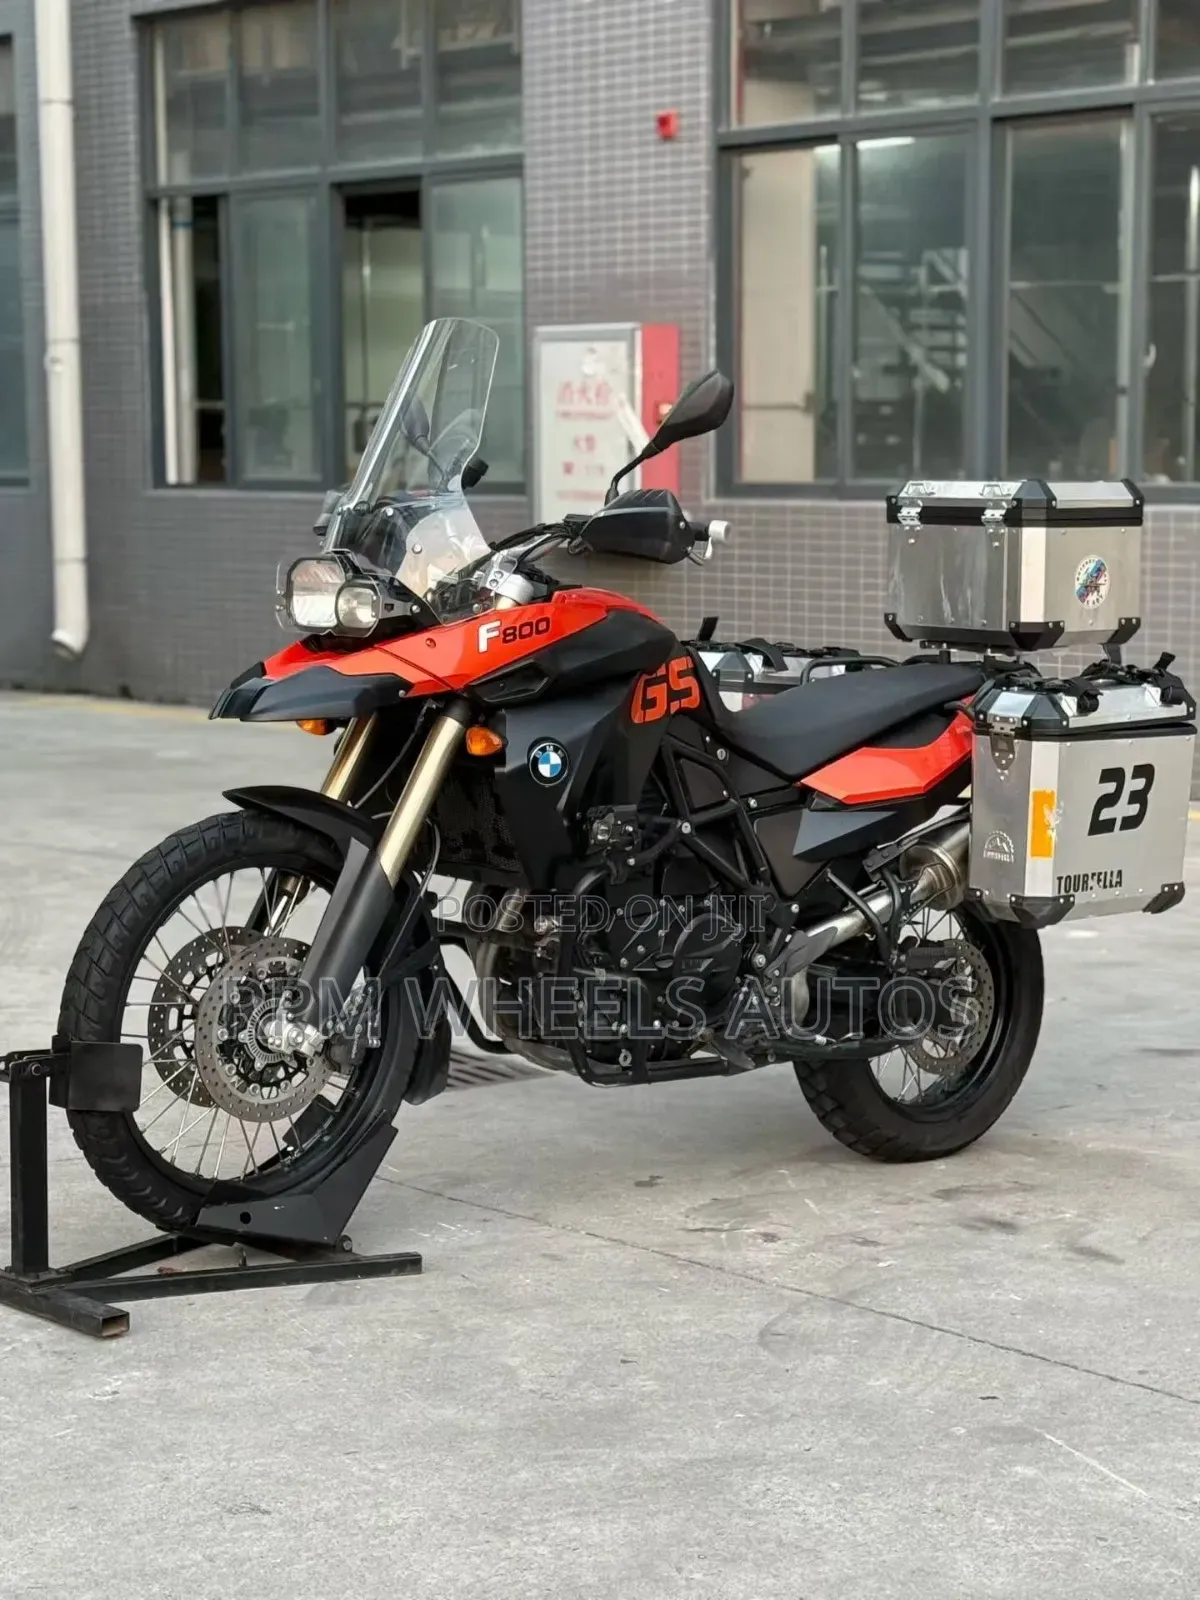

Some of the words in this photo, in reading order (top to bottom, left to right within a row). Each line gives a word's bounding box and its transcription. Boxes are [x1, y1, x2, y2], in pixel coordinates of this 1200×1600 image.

[478, 617, 551, 653] F800
[630, 655, 700, 724] GS
[534, 745, 565, 758] BMW
[1087, 763, 1155, 836] 23
